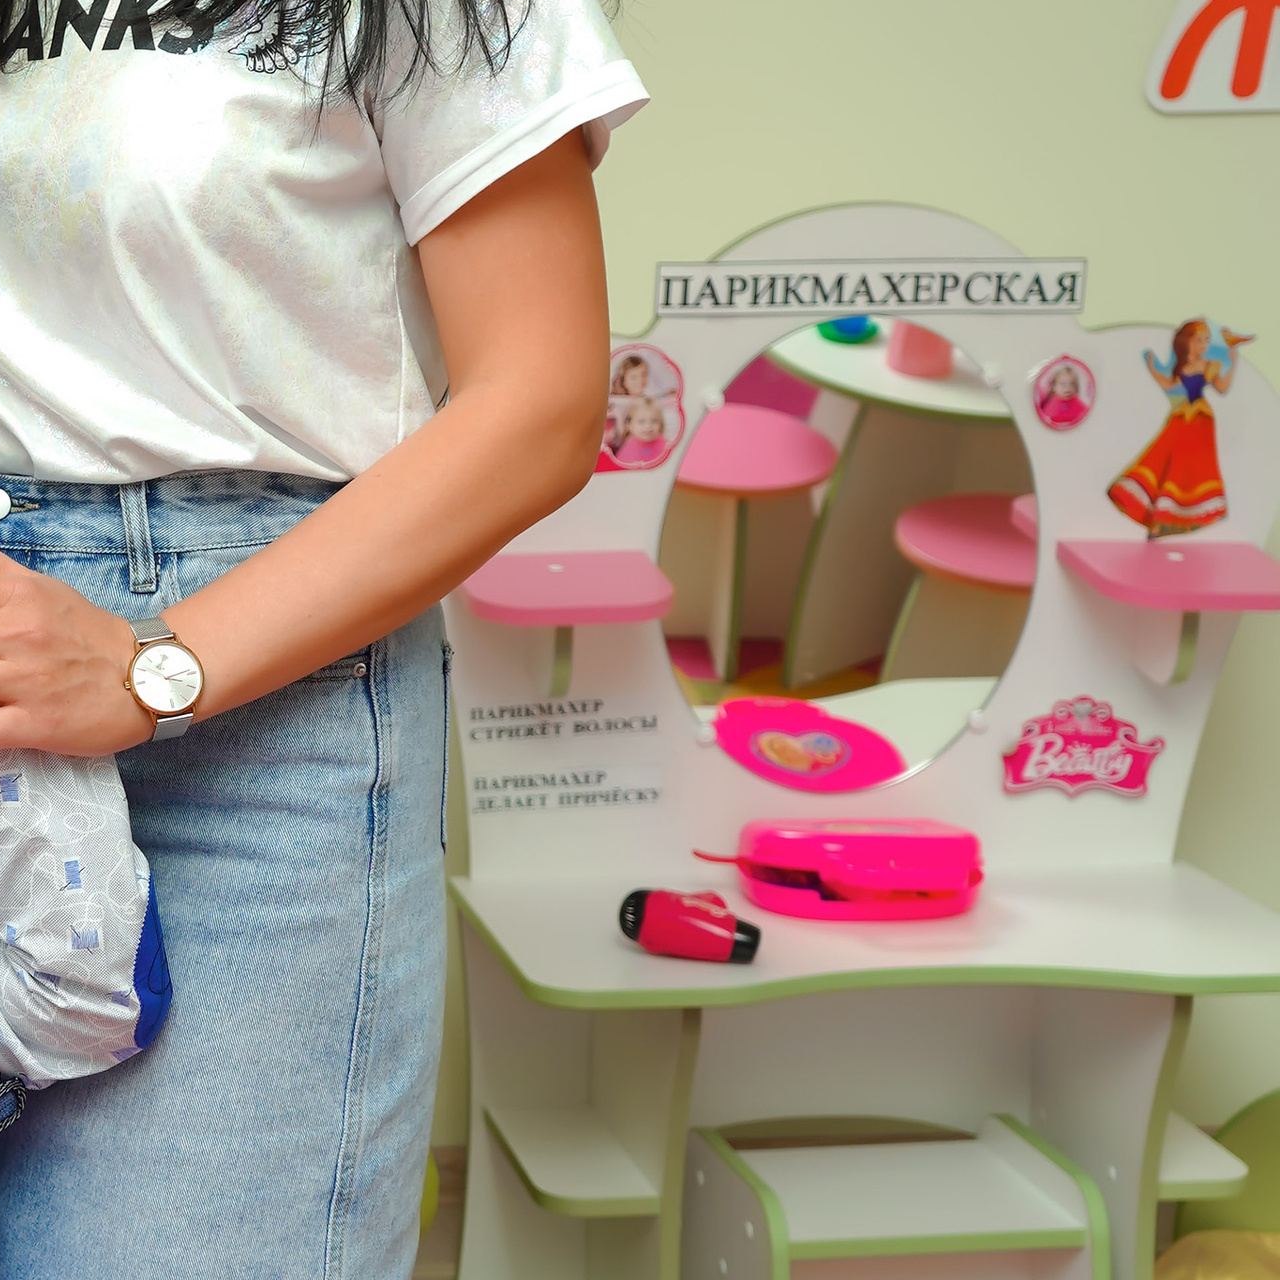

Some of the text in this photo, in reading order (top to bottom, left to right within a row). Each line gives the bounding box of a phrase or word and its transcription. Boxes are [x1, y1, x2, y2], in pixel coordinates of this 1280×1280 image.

[660, 271, 1081, 308] ПАРИКМАХЕРСКАЯ
[470, 699, 604, 721] ПАРИКМАХЕР
[470, 715, 658, 741] СТРИЖЁТ ВОЛОСЫ
[474, 771, 607, 790] ПАРИКМАХЕР
[474, 786, 662, 811] ДЕЛАЕТ ПРИЧЁСКУ
